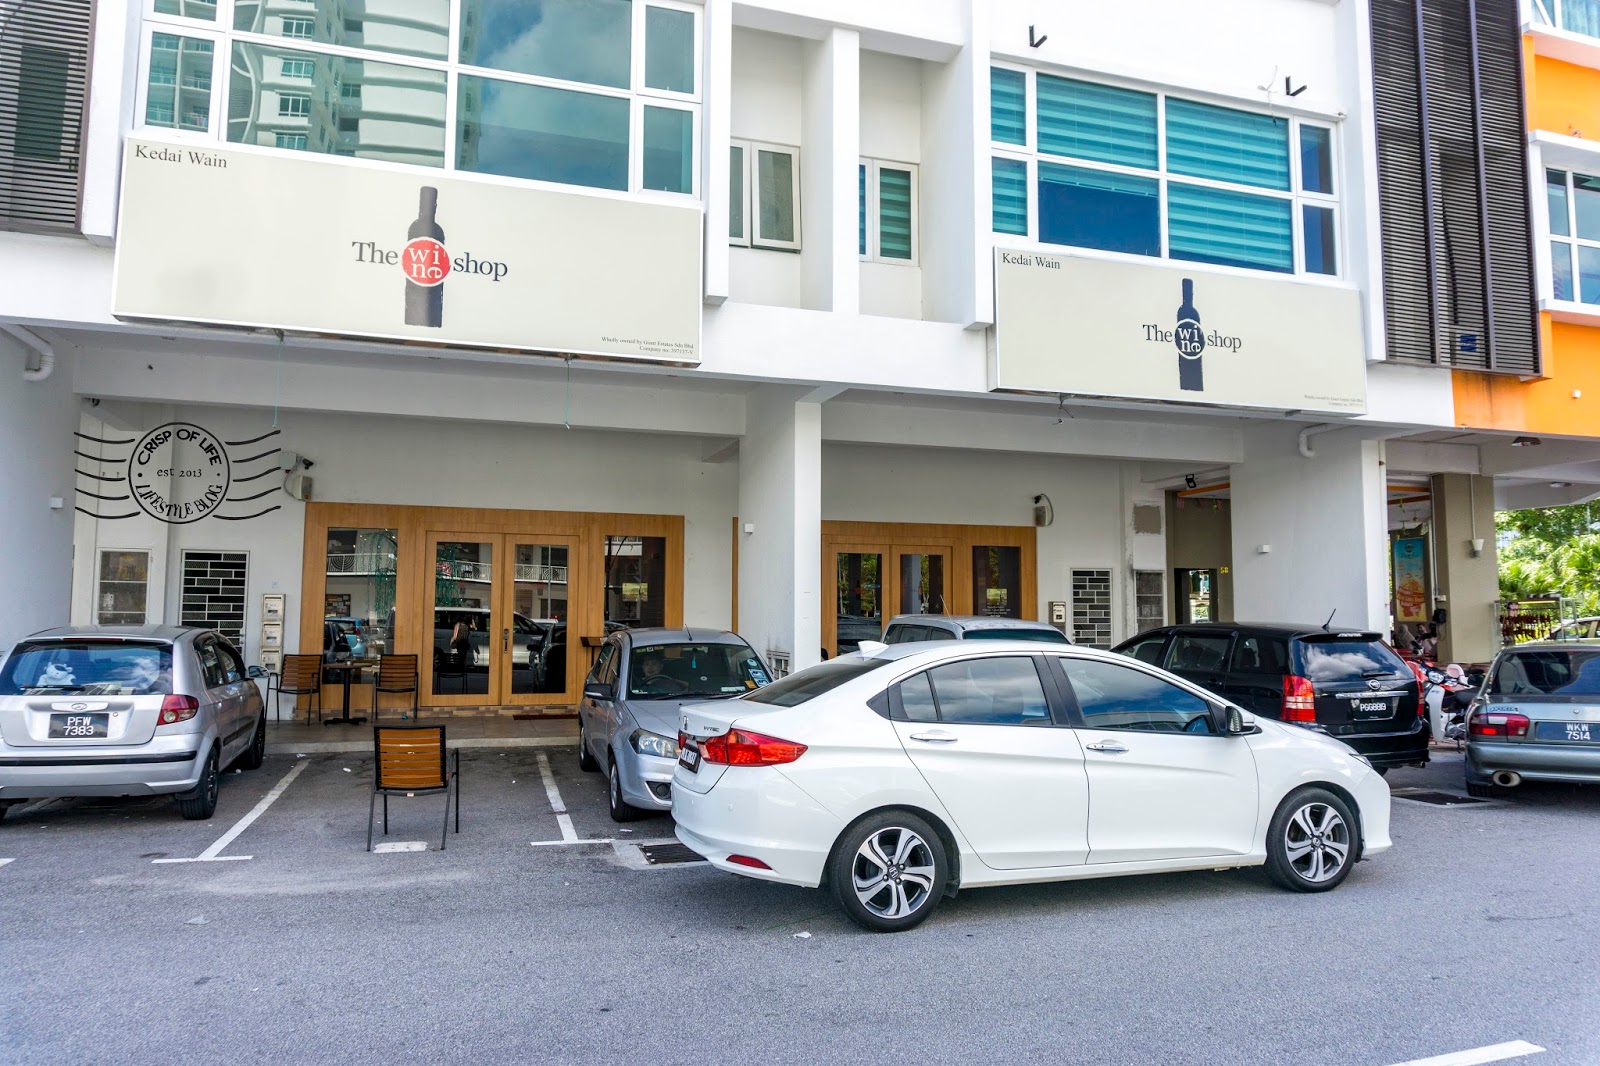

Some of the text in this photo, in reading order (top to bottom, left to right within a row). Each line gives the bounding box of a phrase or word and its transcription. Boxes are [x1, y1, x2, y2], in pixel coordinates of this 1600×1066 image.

[135, 144, 228, 168] Kedai Wain
[351, 241, 398, 265] The
[453, 252, 508, 282] shop
[1002, 252, 1061, 270] Kedai Wain
[1142, 324, 1173, 343] The
[1207, 330, 1242, 352] shop
[67, 717, 91, 726] PFW
[1566, 723, 1589, 731] WKW
[63, 726, 94, 736] 7383
[1565, 731, 1591, 740] 7514
